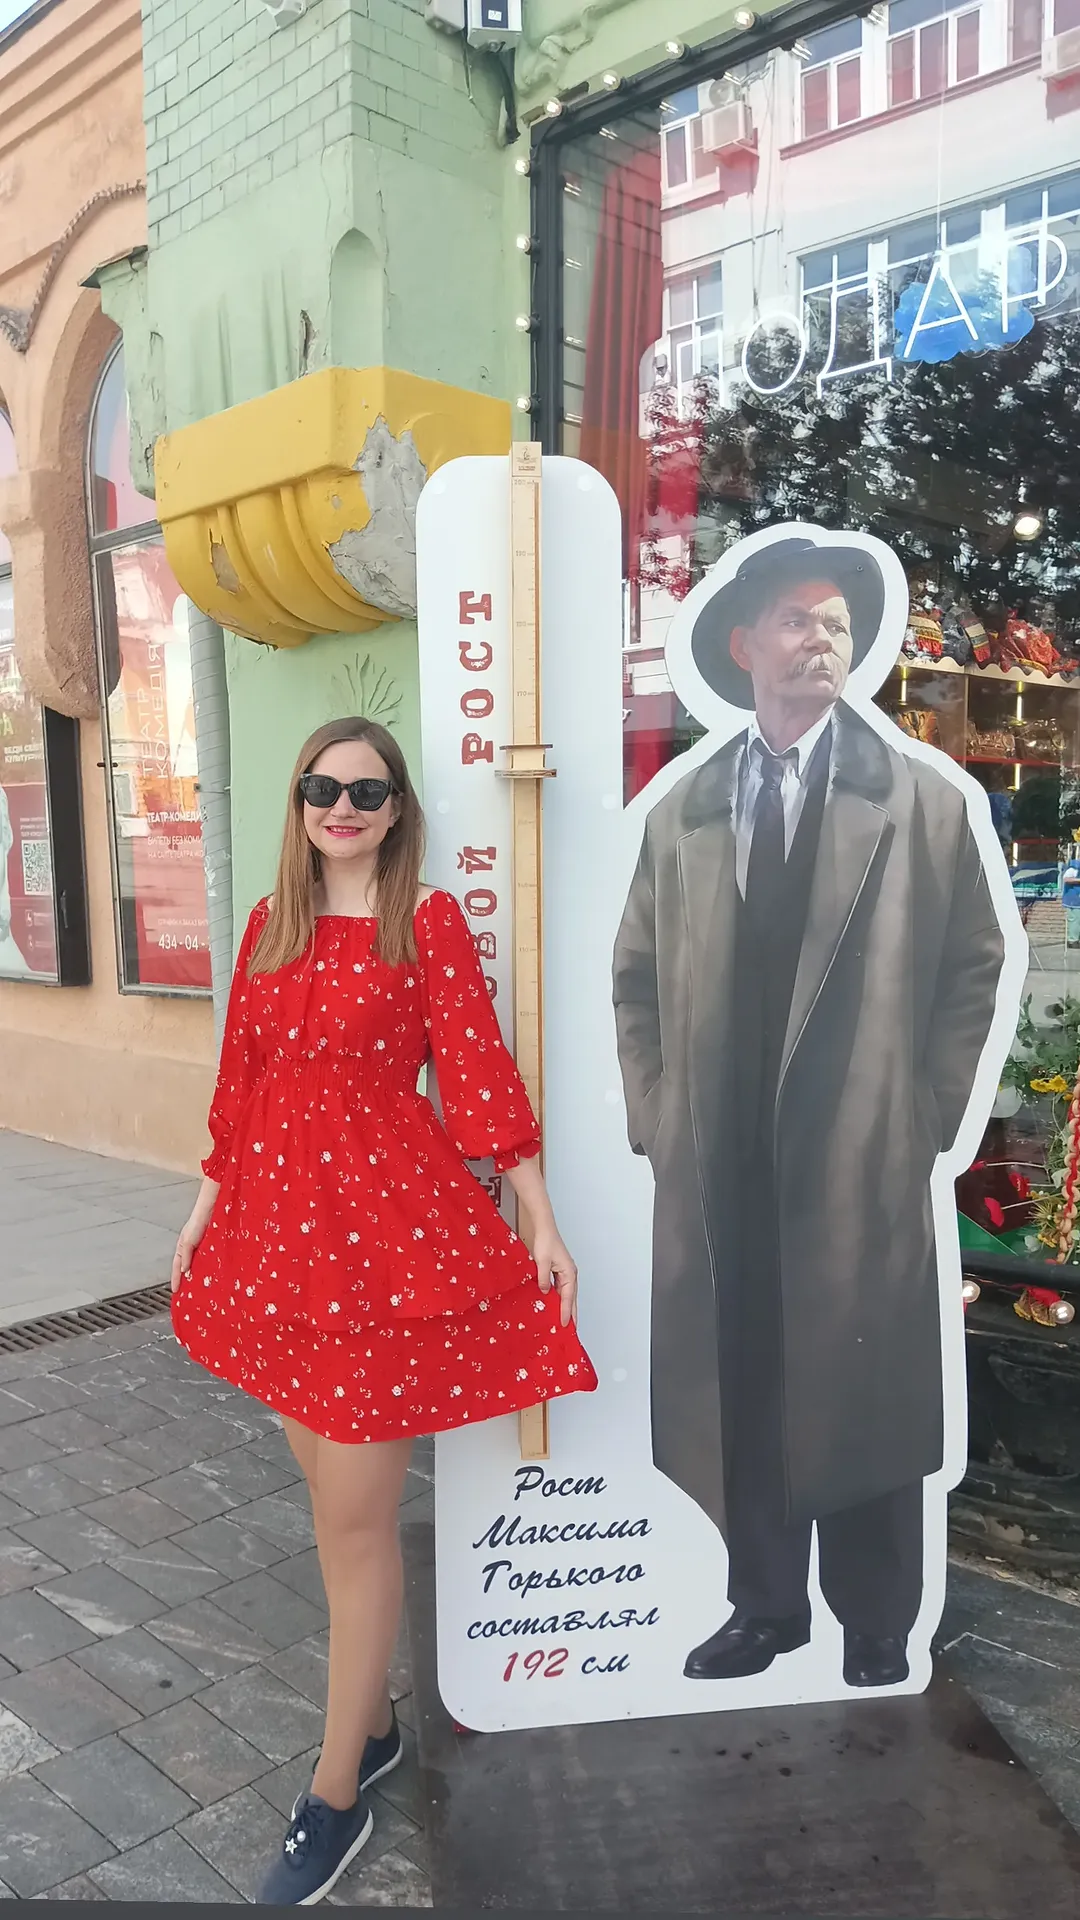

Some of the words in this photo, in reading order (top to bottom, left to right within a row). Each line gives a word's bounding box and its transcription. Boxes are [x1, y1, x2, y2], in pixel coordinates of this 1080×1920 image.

[675, 231, 1069, 424] ПОДАР
[458, 590, 495, 766] РОСТ
[137, 687, 154, 779] ТЕАТР
[513, 1465, 608, 1501] Рост
[472, 1514, 653, 1549] Максима
[481, 1559, 646, 1598] Горького
[466, 1606, 661, 1639] составлял
[502, 1647, 569, 1682] 192
[580, 1652, 630, 1675] см
